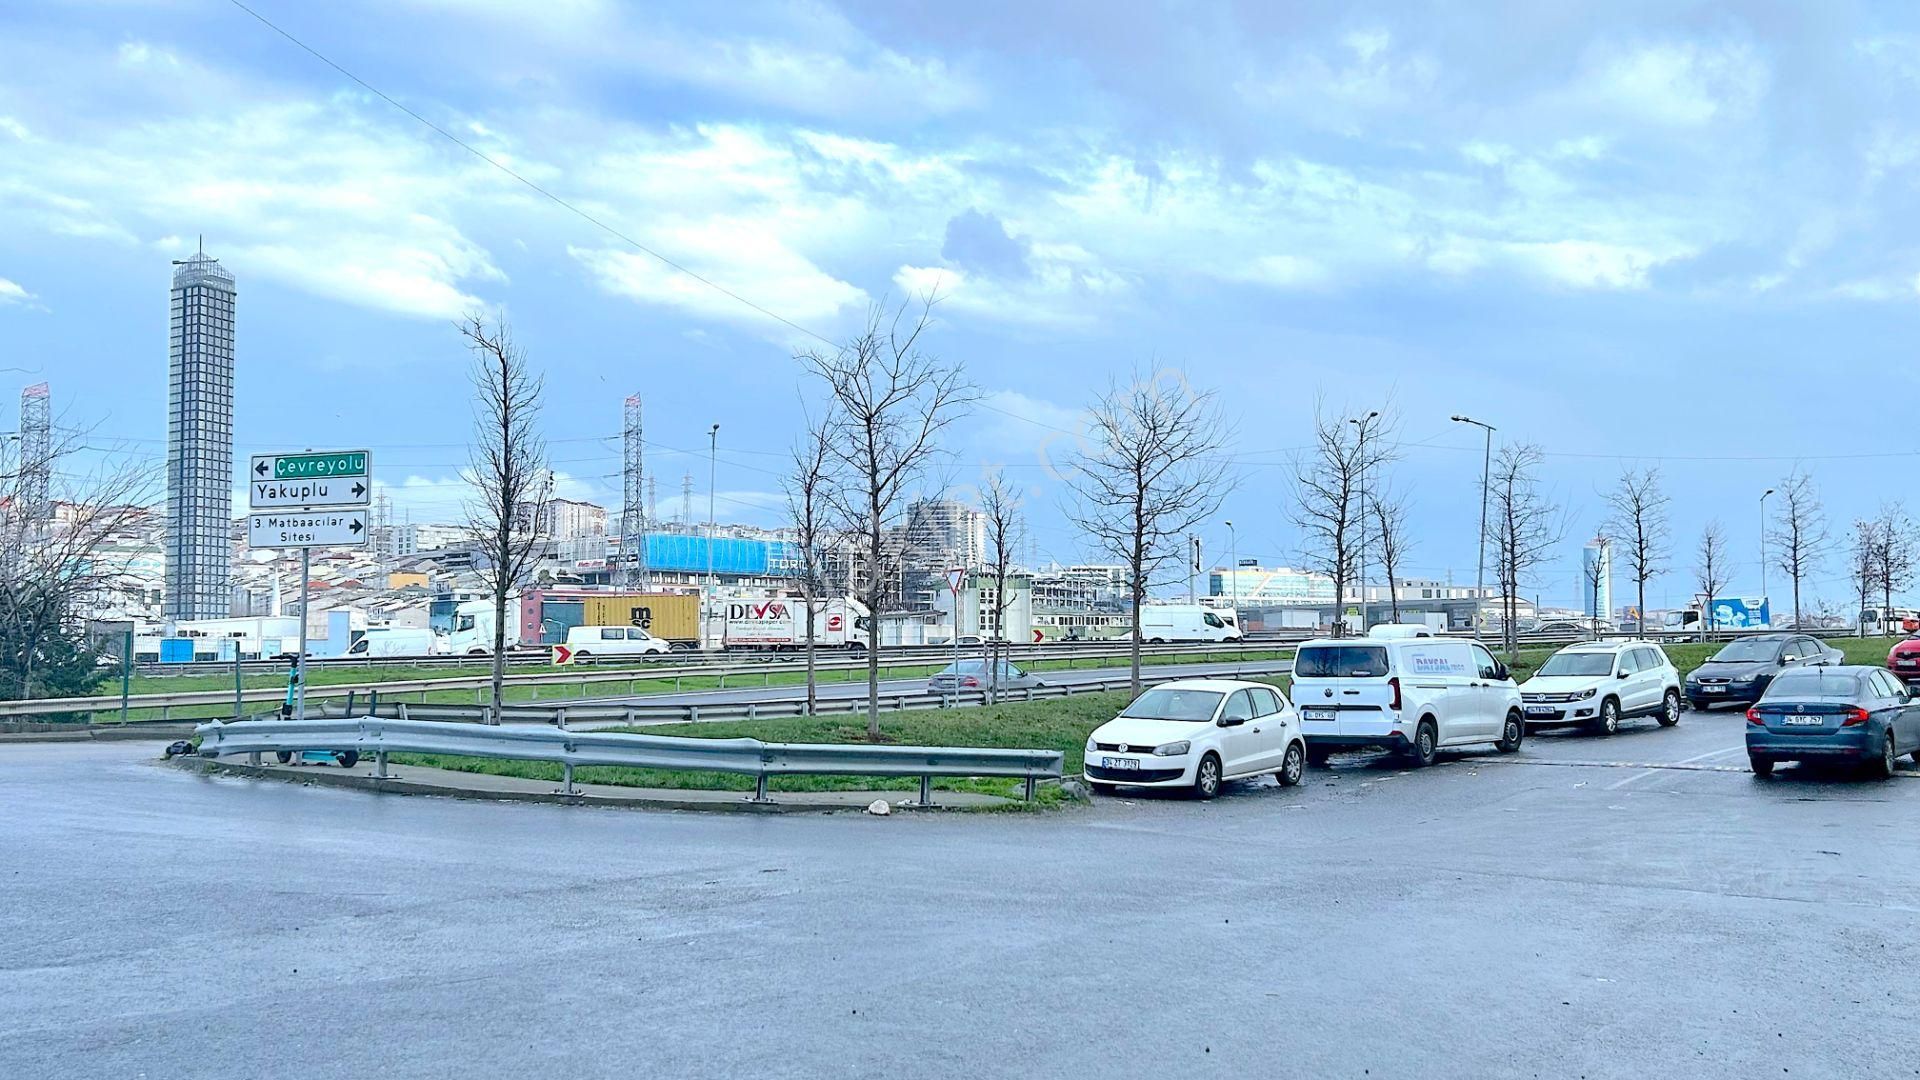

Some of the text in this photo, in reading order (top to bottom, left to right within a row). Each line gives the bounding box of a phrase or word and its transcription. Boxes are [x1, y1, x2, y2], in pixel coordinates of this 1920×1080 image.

[276, 456, 364, 475] Çevreyolu
[257, 482, 328, 501] Yakuplu
[254, 517, 344, 529] 3. Matbaacılar
[280, 532, 315, 542] Sitesi
[730, 599, 791, 619] DEVSA
